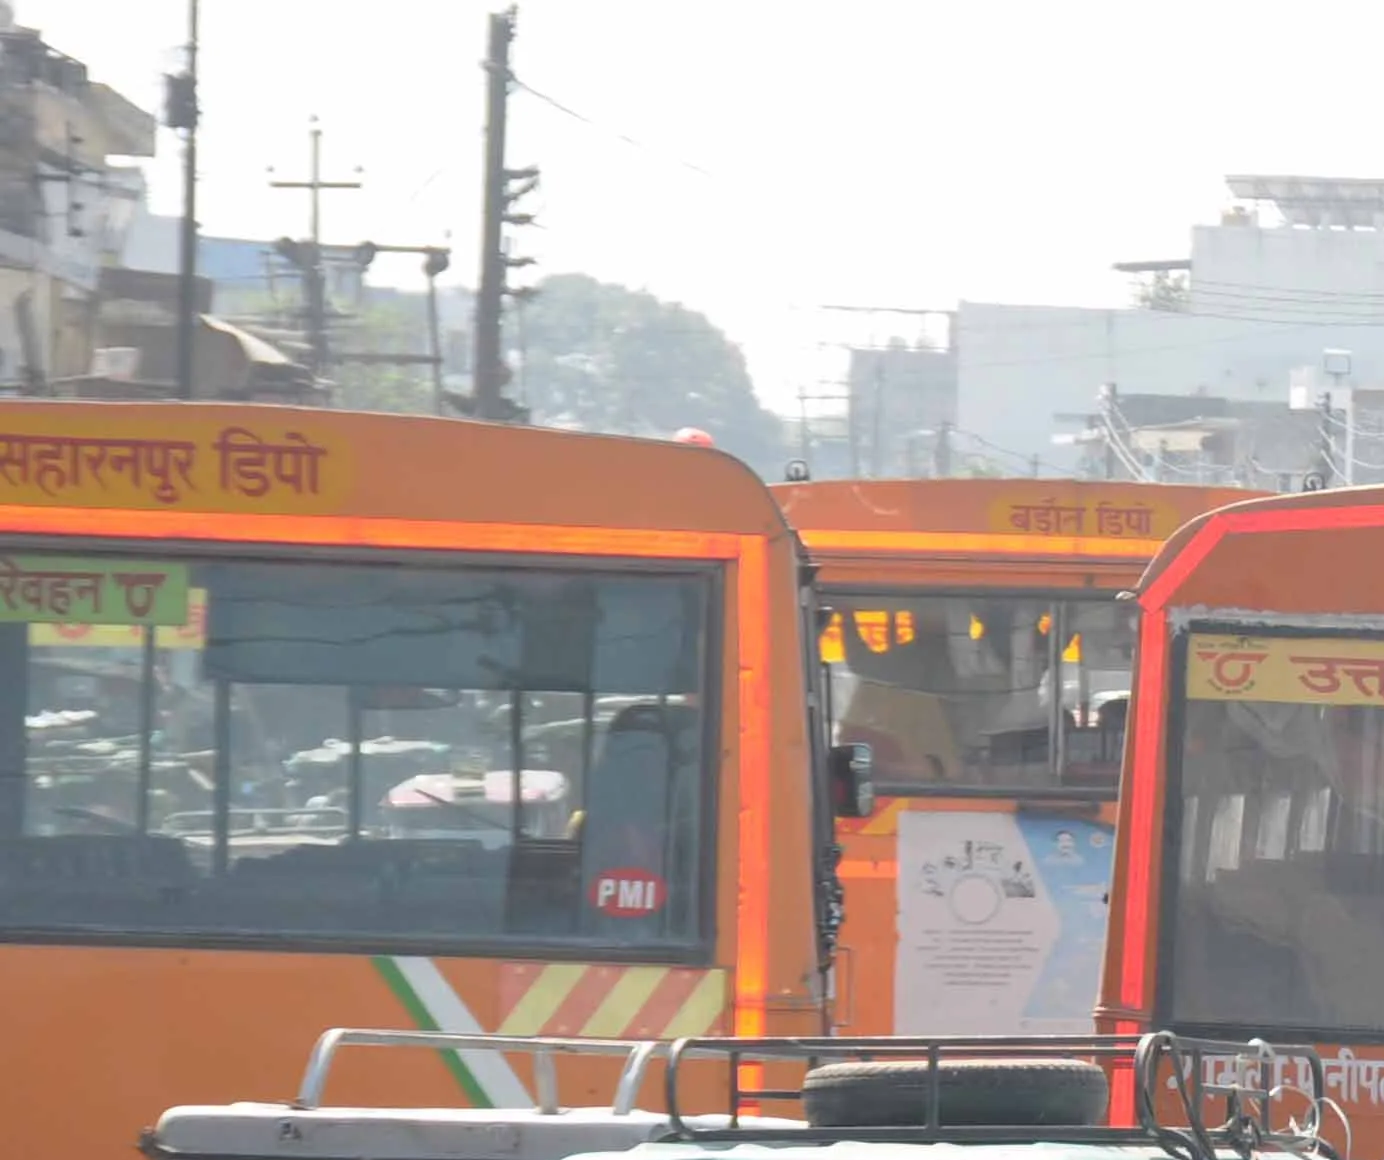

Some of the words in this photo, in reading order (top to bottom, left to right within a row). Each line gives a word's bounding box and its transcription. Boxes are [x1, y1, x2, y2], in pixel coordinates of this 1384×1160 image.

[0, 433, 197, 503] सहारनपुर
[212, 427, 328, 498] डिपो
[1096, 500, 1155, 535] डिपो
[597, 878, 656, 910] PMI
